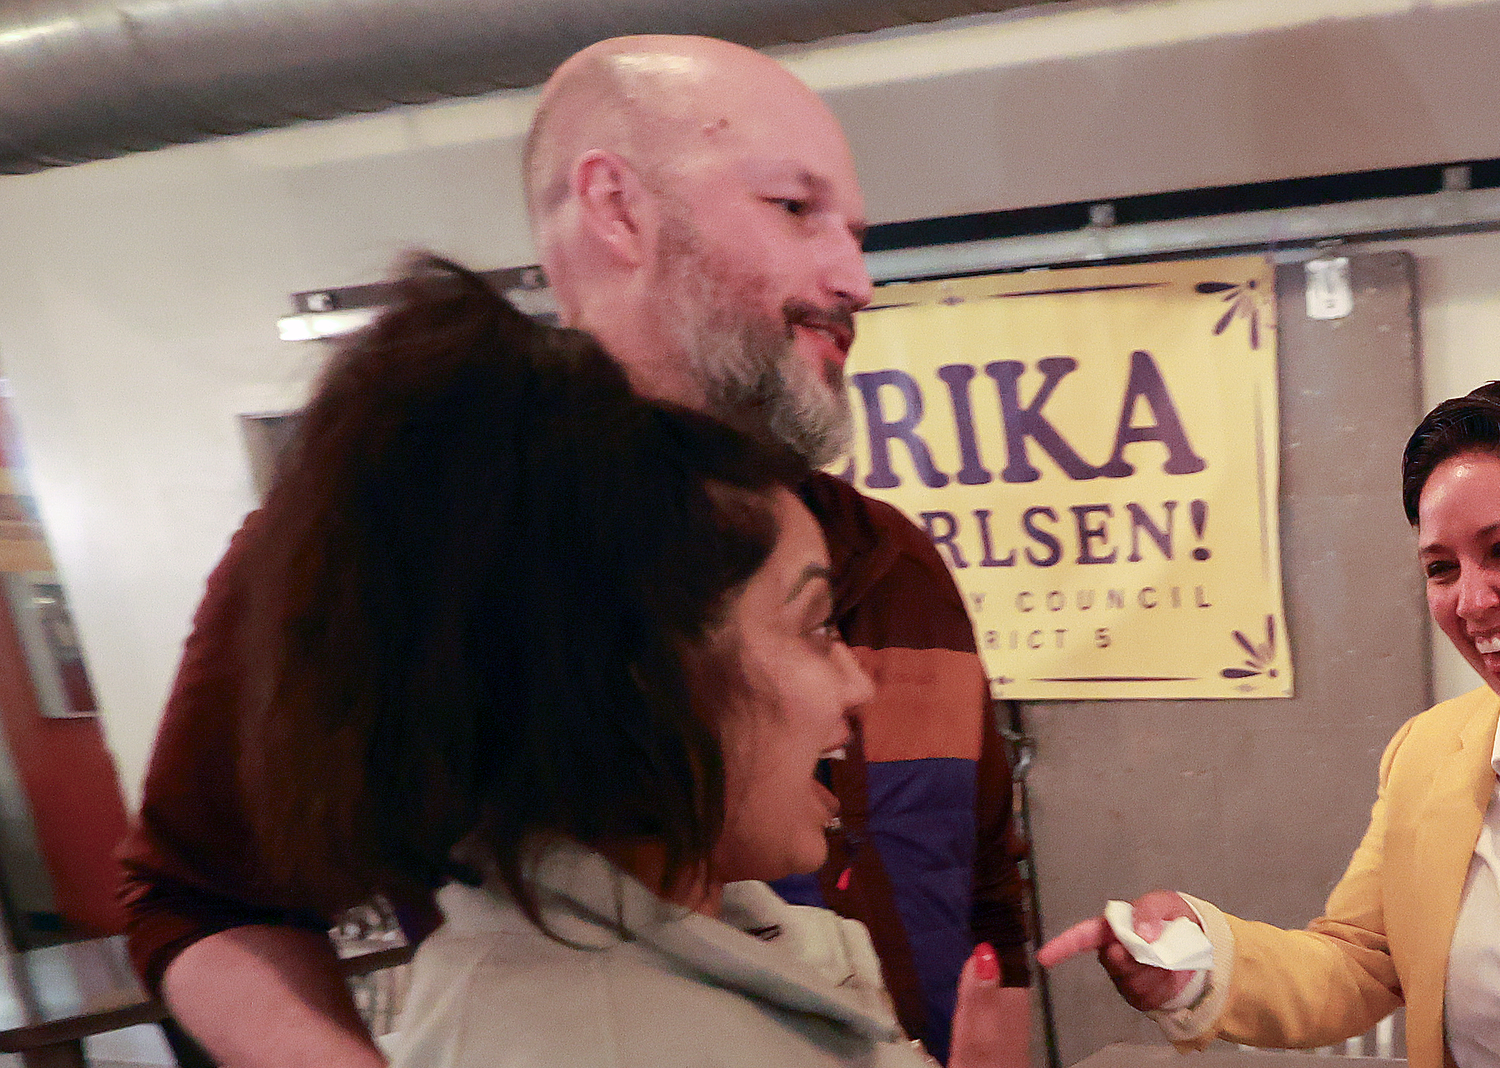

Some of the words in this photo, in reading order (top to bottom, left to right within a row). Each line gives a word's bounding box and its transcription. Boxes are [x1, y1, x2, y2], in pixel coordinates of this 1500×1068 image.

[841, 349, 1207, 489] RIKA
[918, 499, 1212, 569] RLSEN!
[1015, 585, 1213, 613] COUNCIL
[983, 628, 1069, 650] RICT
